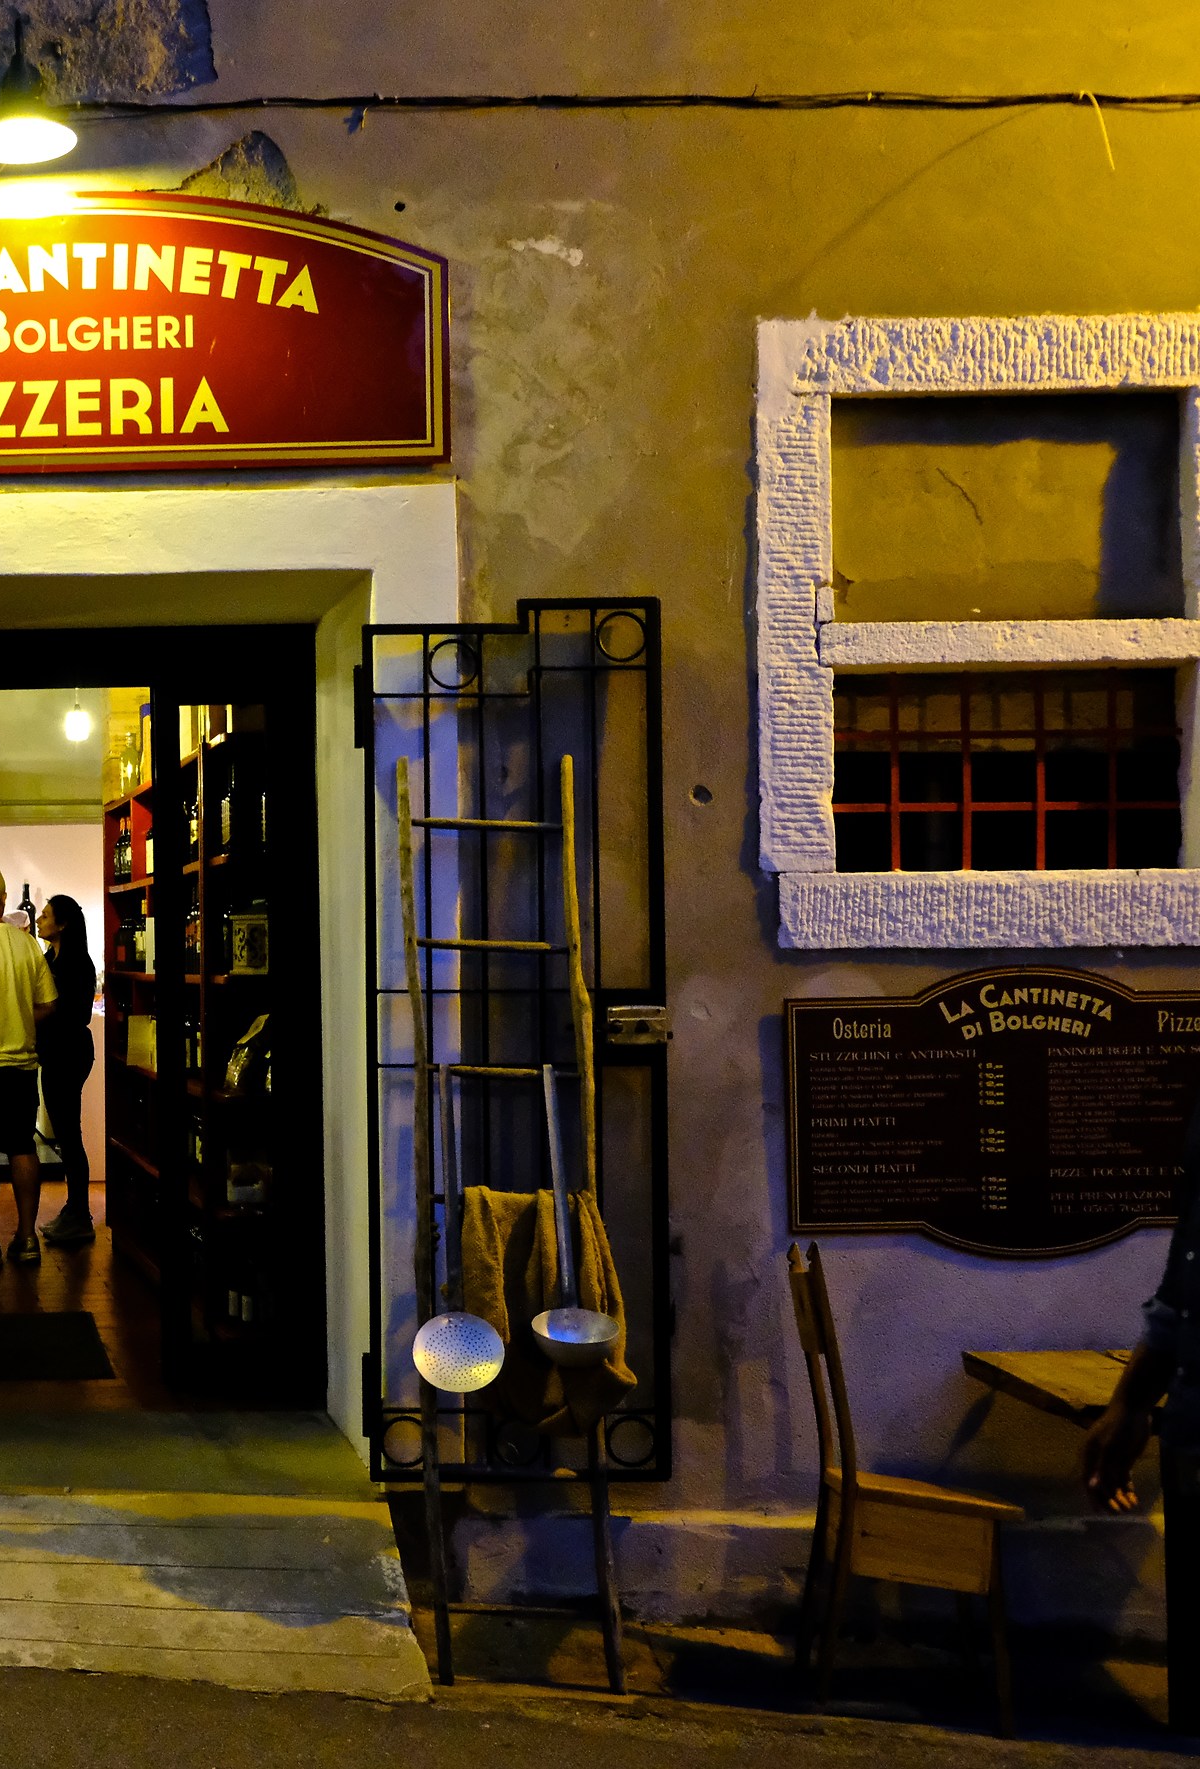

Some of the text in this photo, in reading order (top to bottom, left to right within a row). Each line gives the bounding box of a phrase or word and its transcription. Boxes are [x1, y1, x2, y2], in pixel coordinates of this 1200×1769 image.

[938, 984, 1113, 1024] LA CANTINETTA
[832, 1018, 892, 1039] Osteria
[961, 1011, 1093, 1041] DI BOLGHERI
[909, 1049, 977, 1060] ANTIPASTI
[811, 1117, 848, 1127] PRIMI
[812, 1164, 870, 1174] SECONDI
